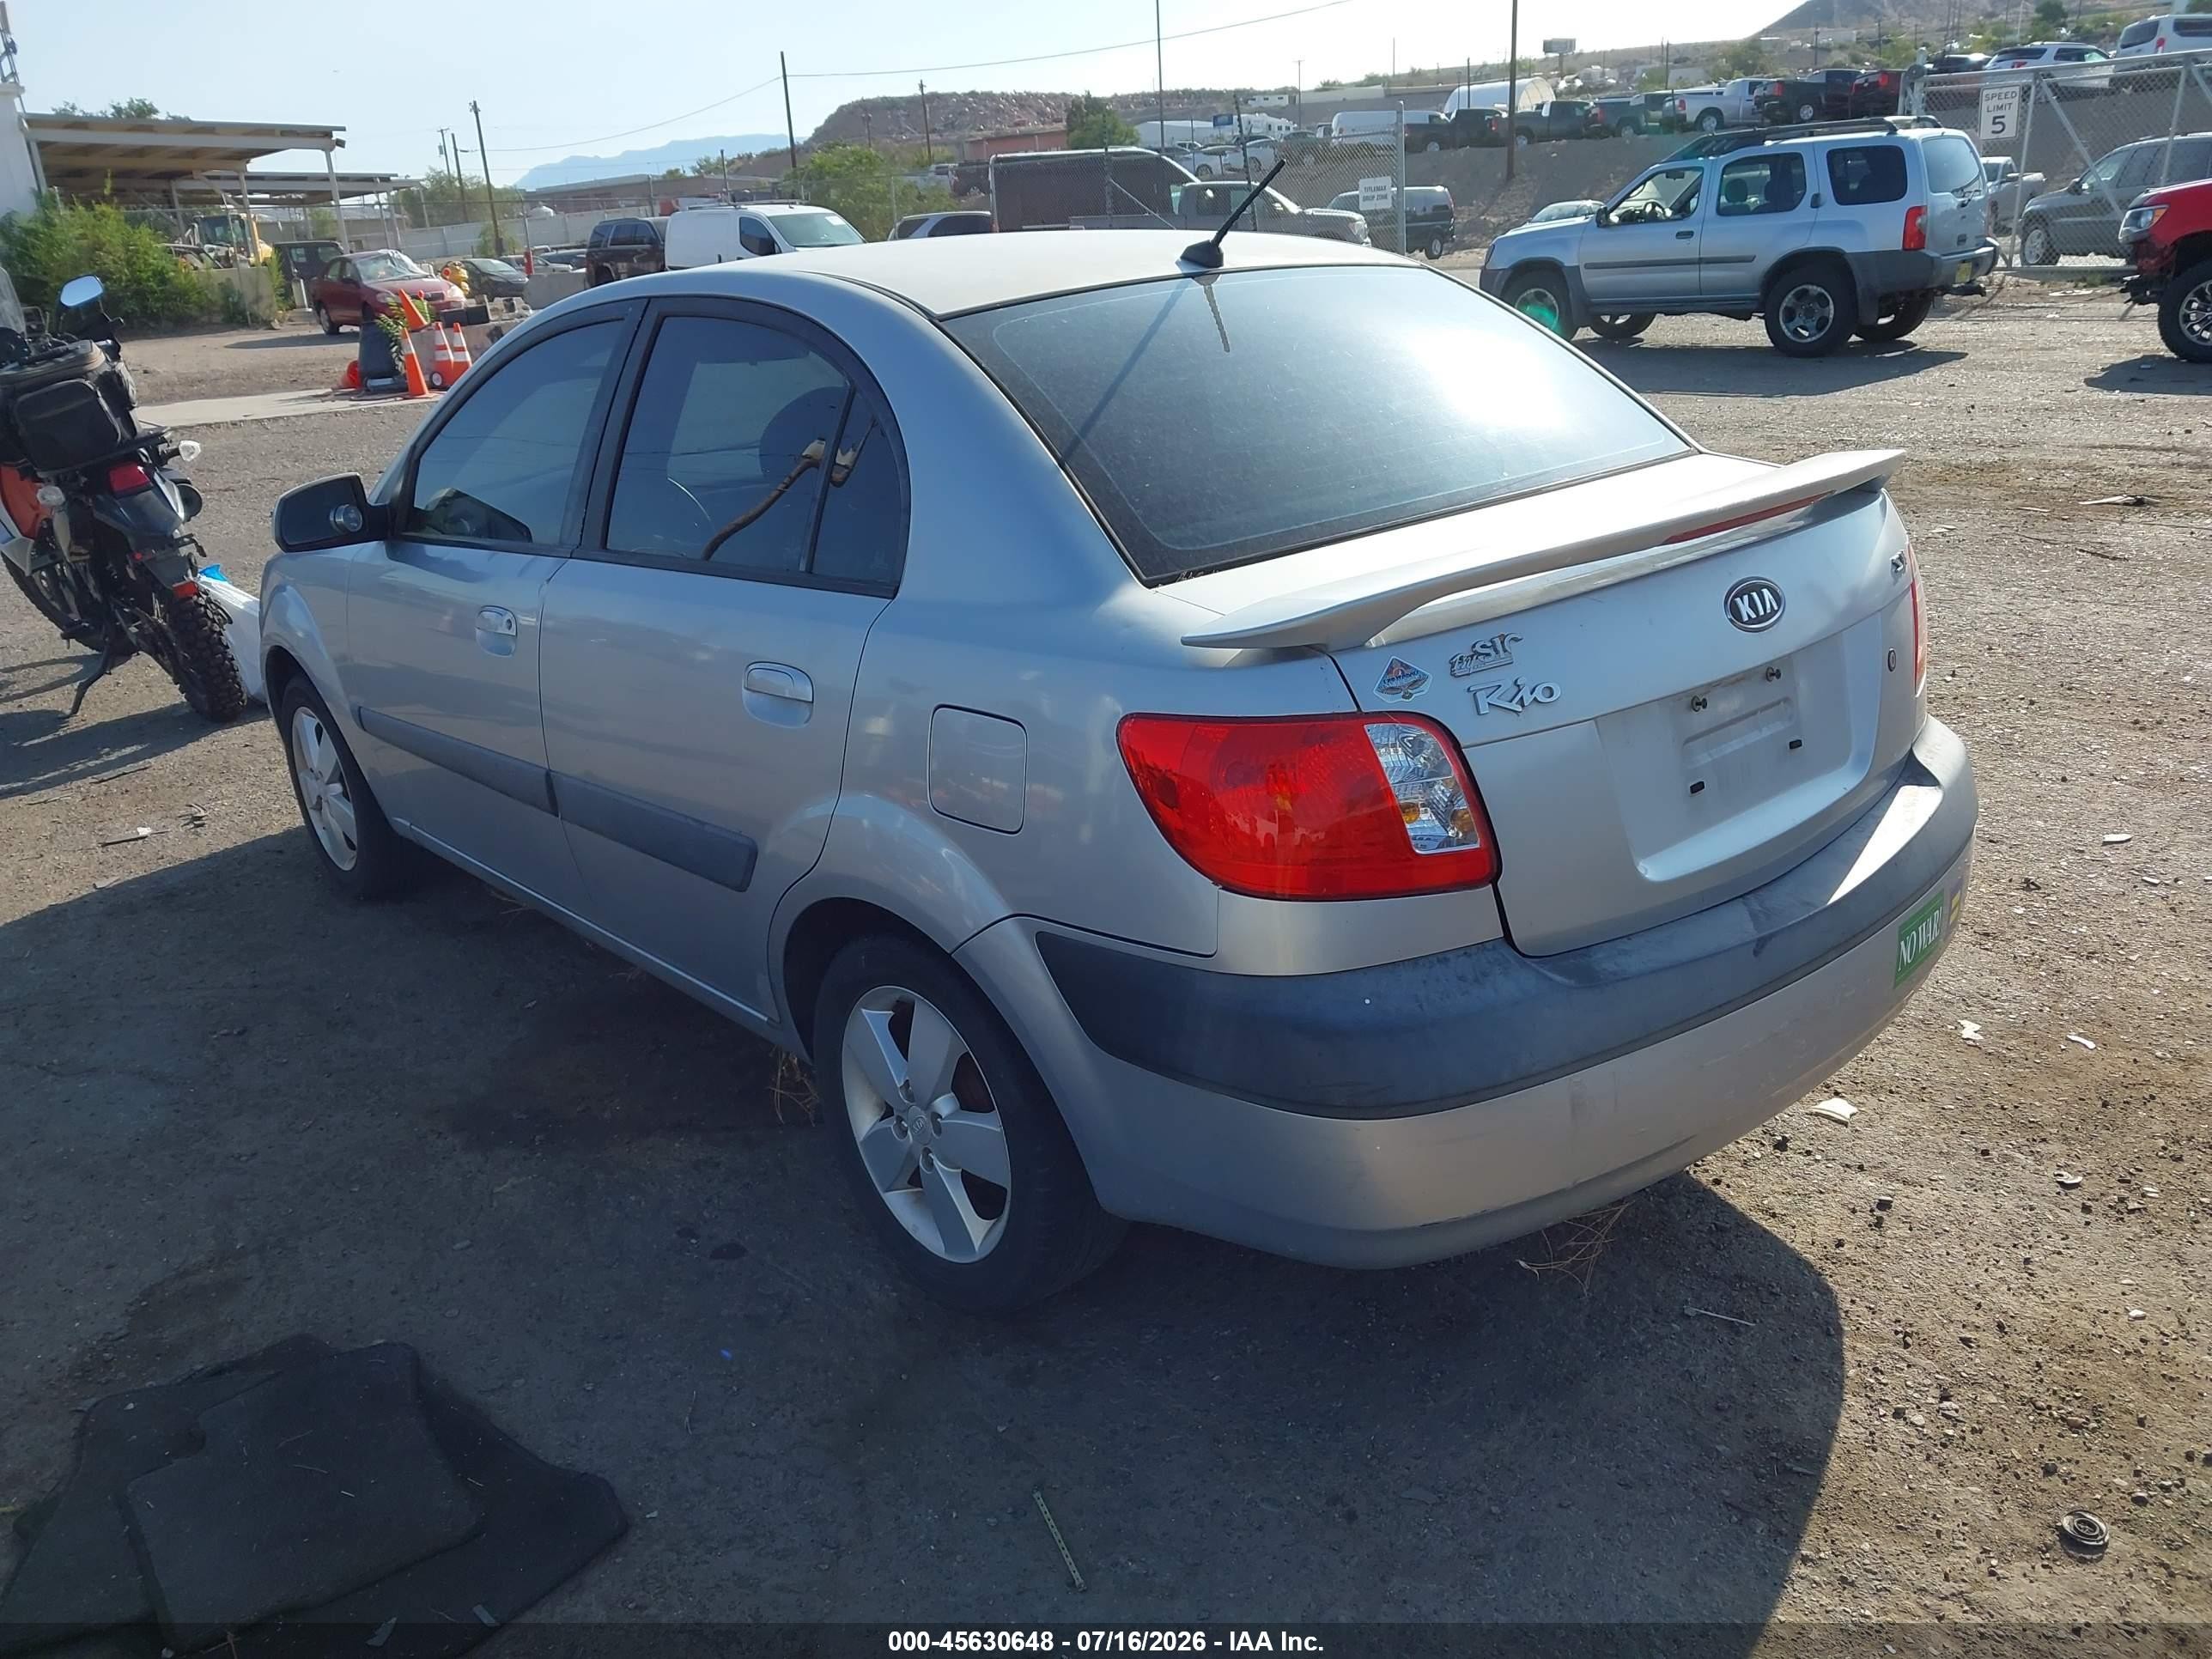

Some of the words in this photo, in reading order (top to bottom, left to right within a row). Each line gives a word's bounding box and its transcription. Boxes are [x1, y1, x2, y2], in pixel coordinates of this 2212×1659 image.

[1984, 90, 2017, 101] SPEED
[1986, 102, 2013, 112] LIMIT
[1991, 115, 2006, 134] 5
[1734, 588, 1778, 622] KIA
[1468, 676, 1561, 715] Rio
[1898, 930, 1917, 972] NO
